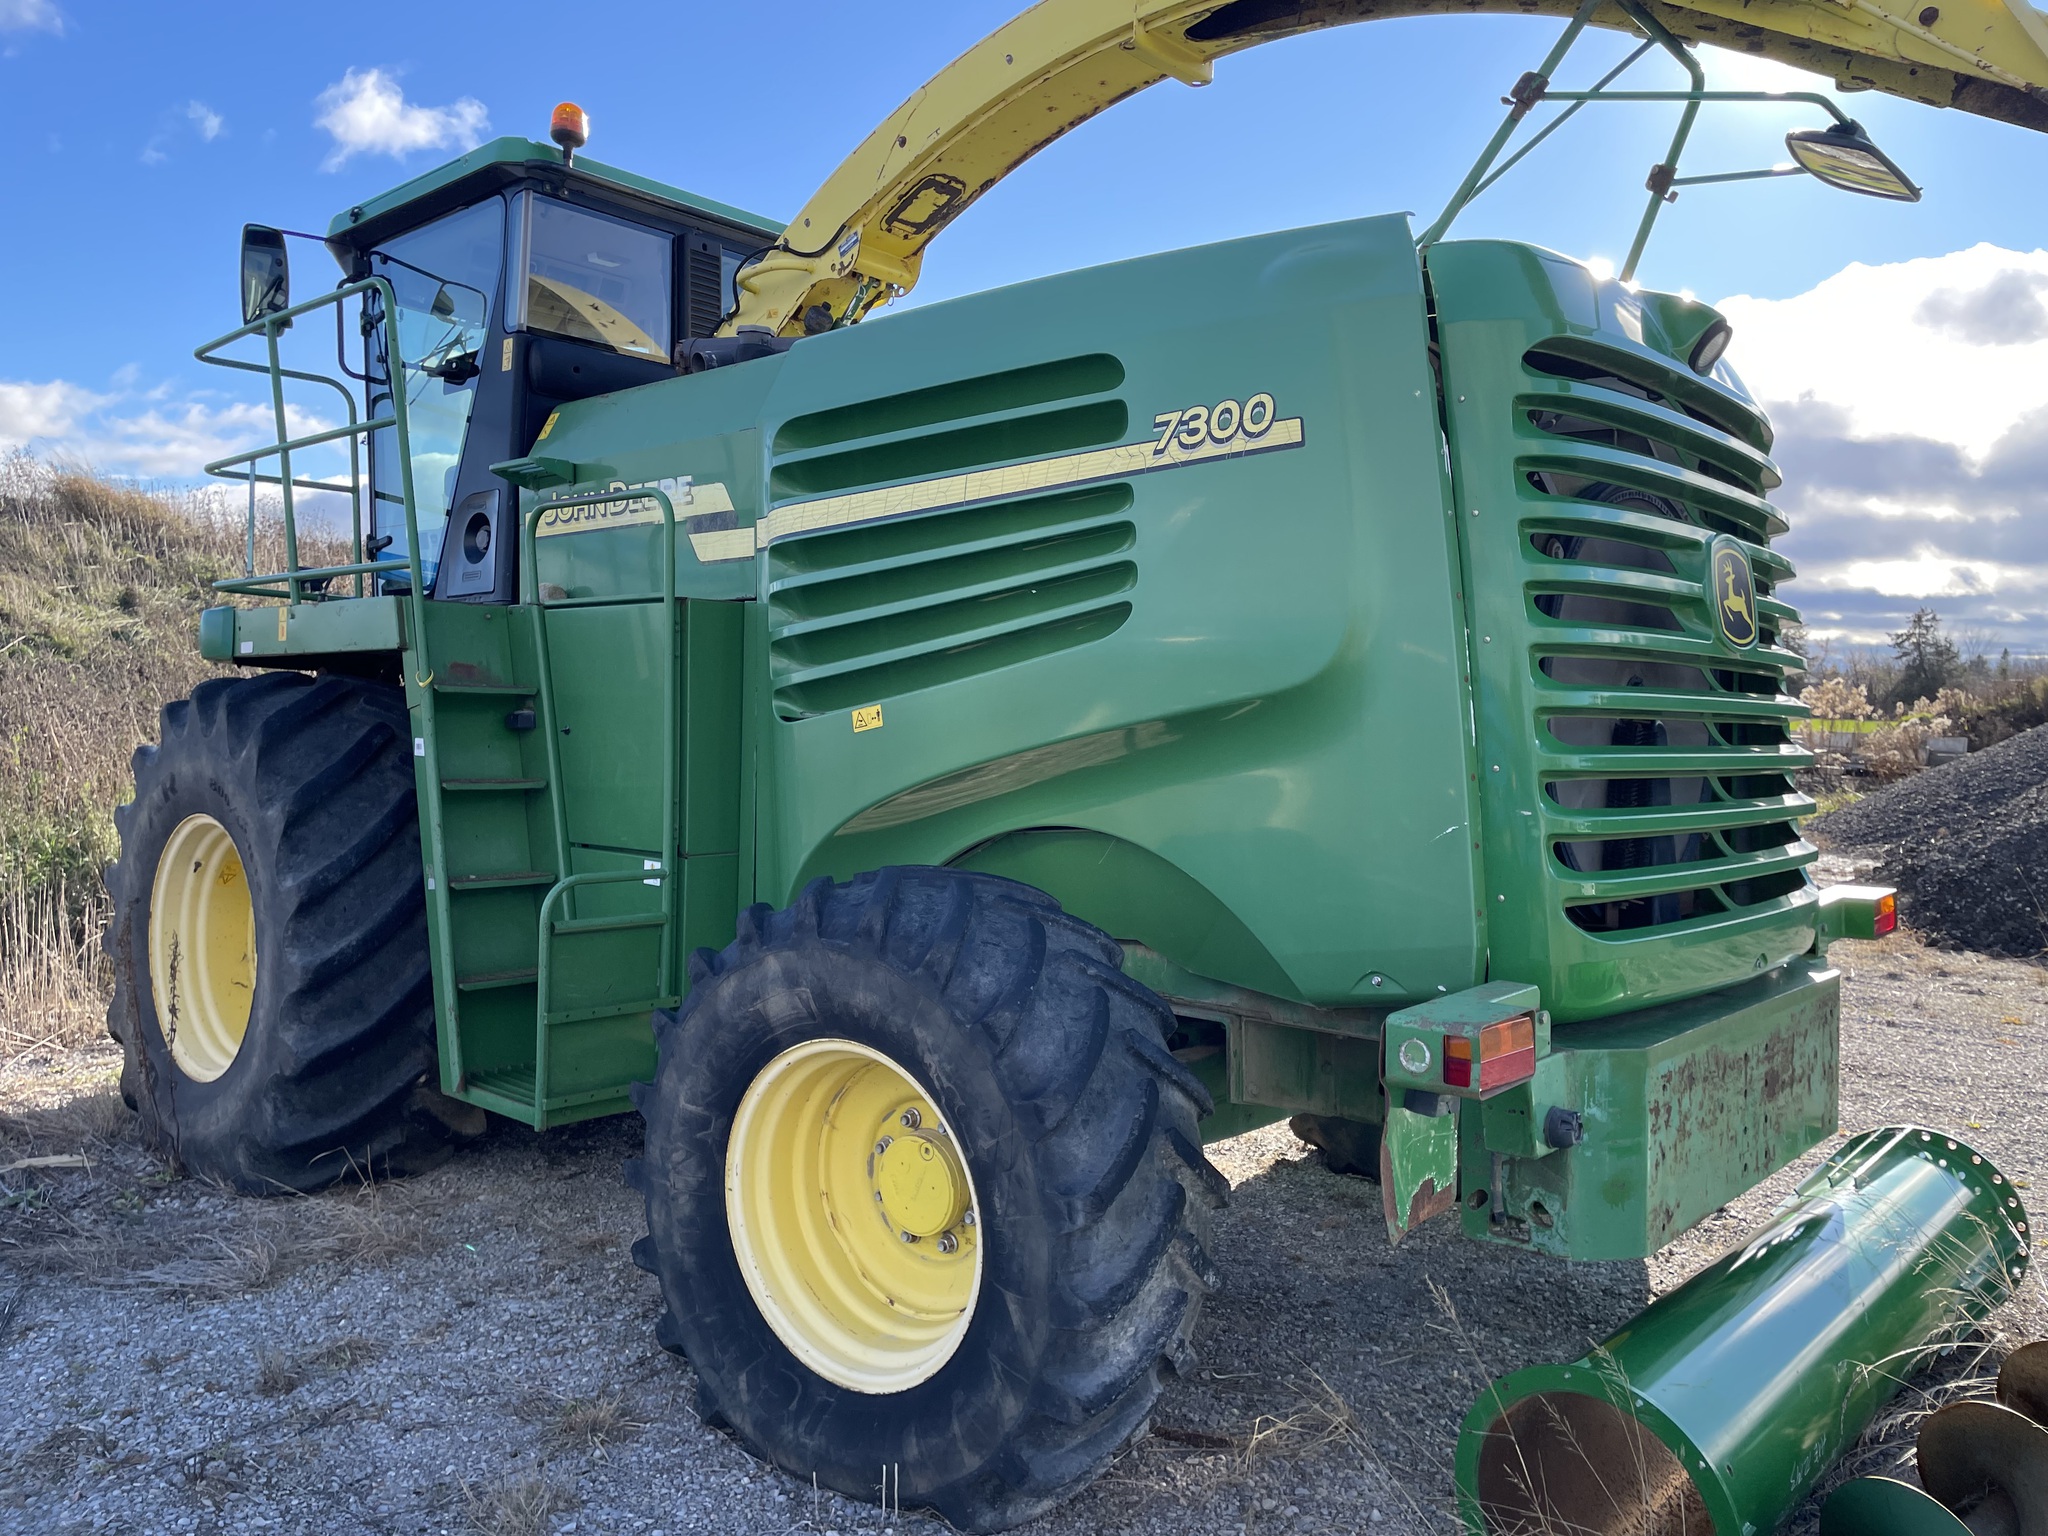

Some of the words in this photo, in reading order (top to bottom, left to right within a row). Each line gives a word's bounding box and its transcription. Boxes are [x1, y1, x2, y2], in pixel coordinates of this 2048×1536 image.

[1153, 392, 1276, 458] 7300
[544, 489, 607, 526] JOHN
[608, 475, 694, 518] DEERE
